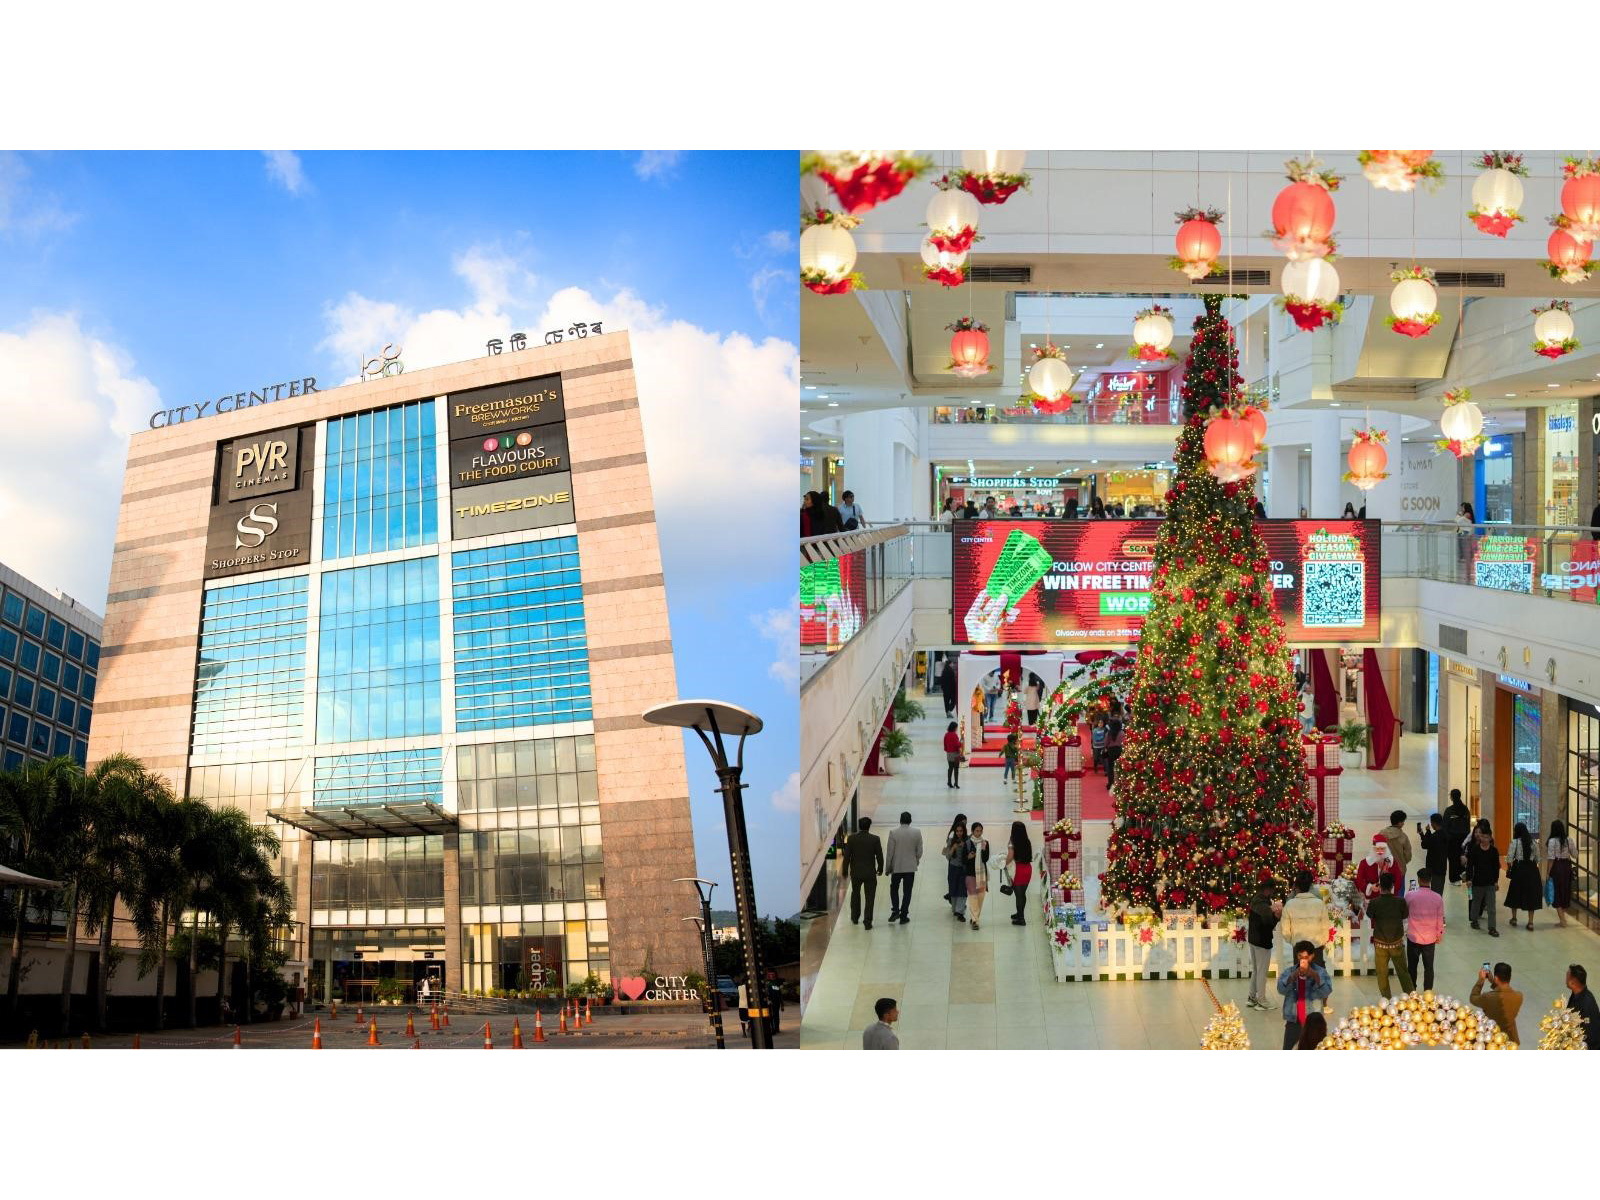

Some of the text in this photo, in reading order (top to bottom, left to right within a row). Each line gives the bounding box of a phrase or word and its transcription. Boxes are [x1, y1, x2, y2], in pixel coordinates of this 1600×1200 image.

[150, 377, 321, 429] CITY CENTER
[455, 390, 557, 417] Freemason's
[471, 403, 540, 423] BREWWORKS
[236, 441, 288, 477] PVR
[472, 446, 545, 468] FLAVOURS
[459, 456, 560, 481] THE FOOD COURT
[236, 472, 288, 488] CINEMAS
[970, 477, 1026, 488] SHOPPERS
[1030, 477, 1059, 488] STOP
[456, 491, 570, 518] TIMEZONE
[1410, 496, 1440, 511] SOON
[1309, 535, 1349, 543] HOLIDAY
[1315, 543, 1351, 551] SEASON
[211, 549, 299, 569] SHOPPERS STOP
[1309, 552, 1357, 561] GIVEAWAY
[1052, 562, 1093, 572] FOLLOW
[1096, 562, 1121, 572] CITY
[1270, 561, 1284, 571] TO
[1043, 575, 1079, 589] WIN
[1082, 575, 1121, 589] FREE
[1106, 596, 1152, 612] WOR
[654, 976, 688, 988] CITY
[645, 989, 700, 1001] CENTER
